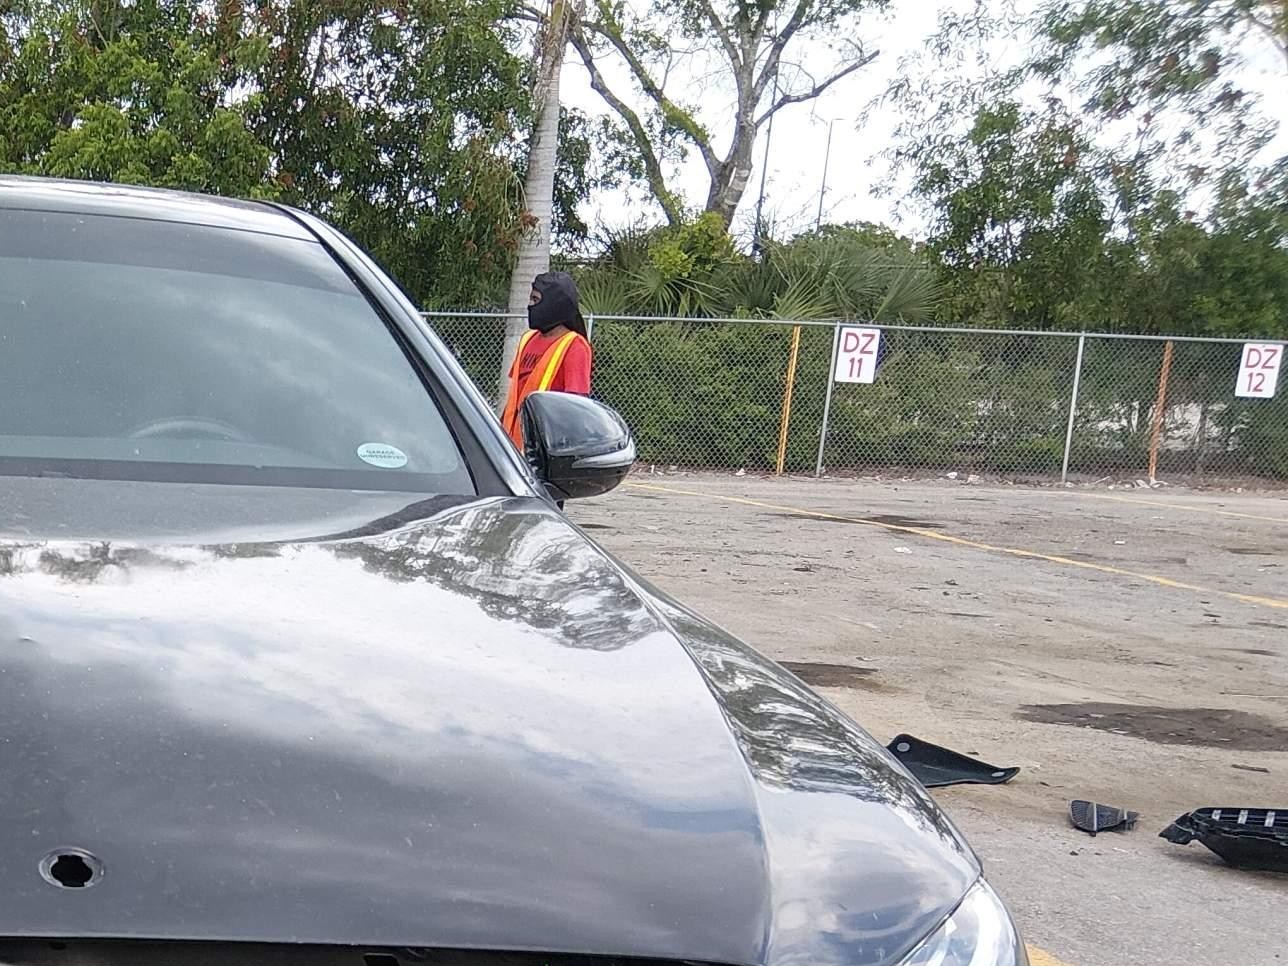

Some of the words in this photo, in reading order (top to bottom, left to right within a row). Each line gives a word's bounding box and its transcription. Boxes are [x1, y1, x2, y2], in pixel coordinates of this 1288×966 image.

[843, 332, 876, 355] DZ
[849, 357, 863, 378] 11
[1245, 348, 1278, 369] DZ
[1246, 372, 1265, 392] 12
